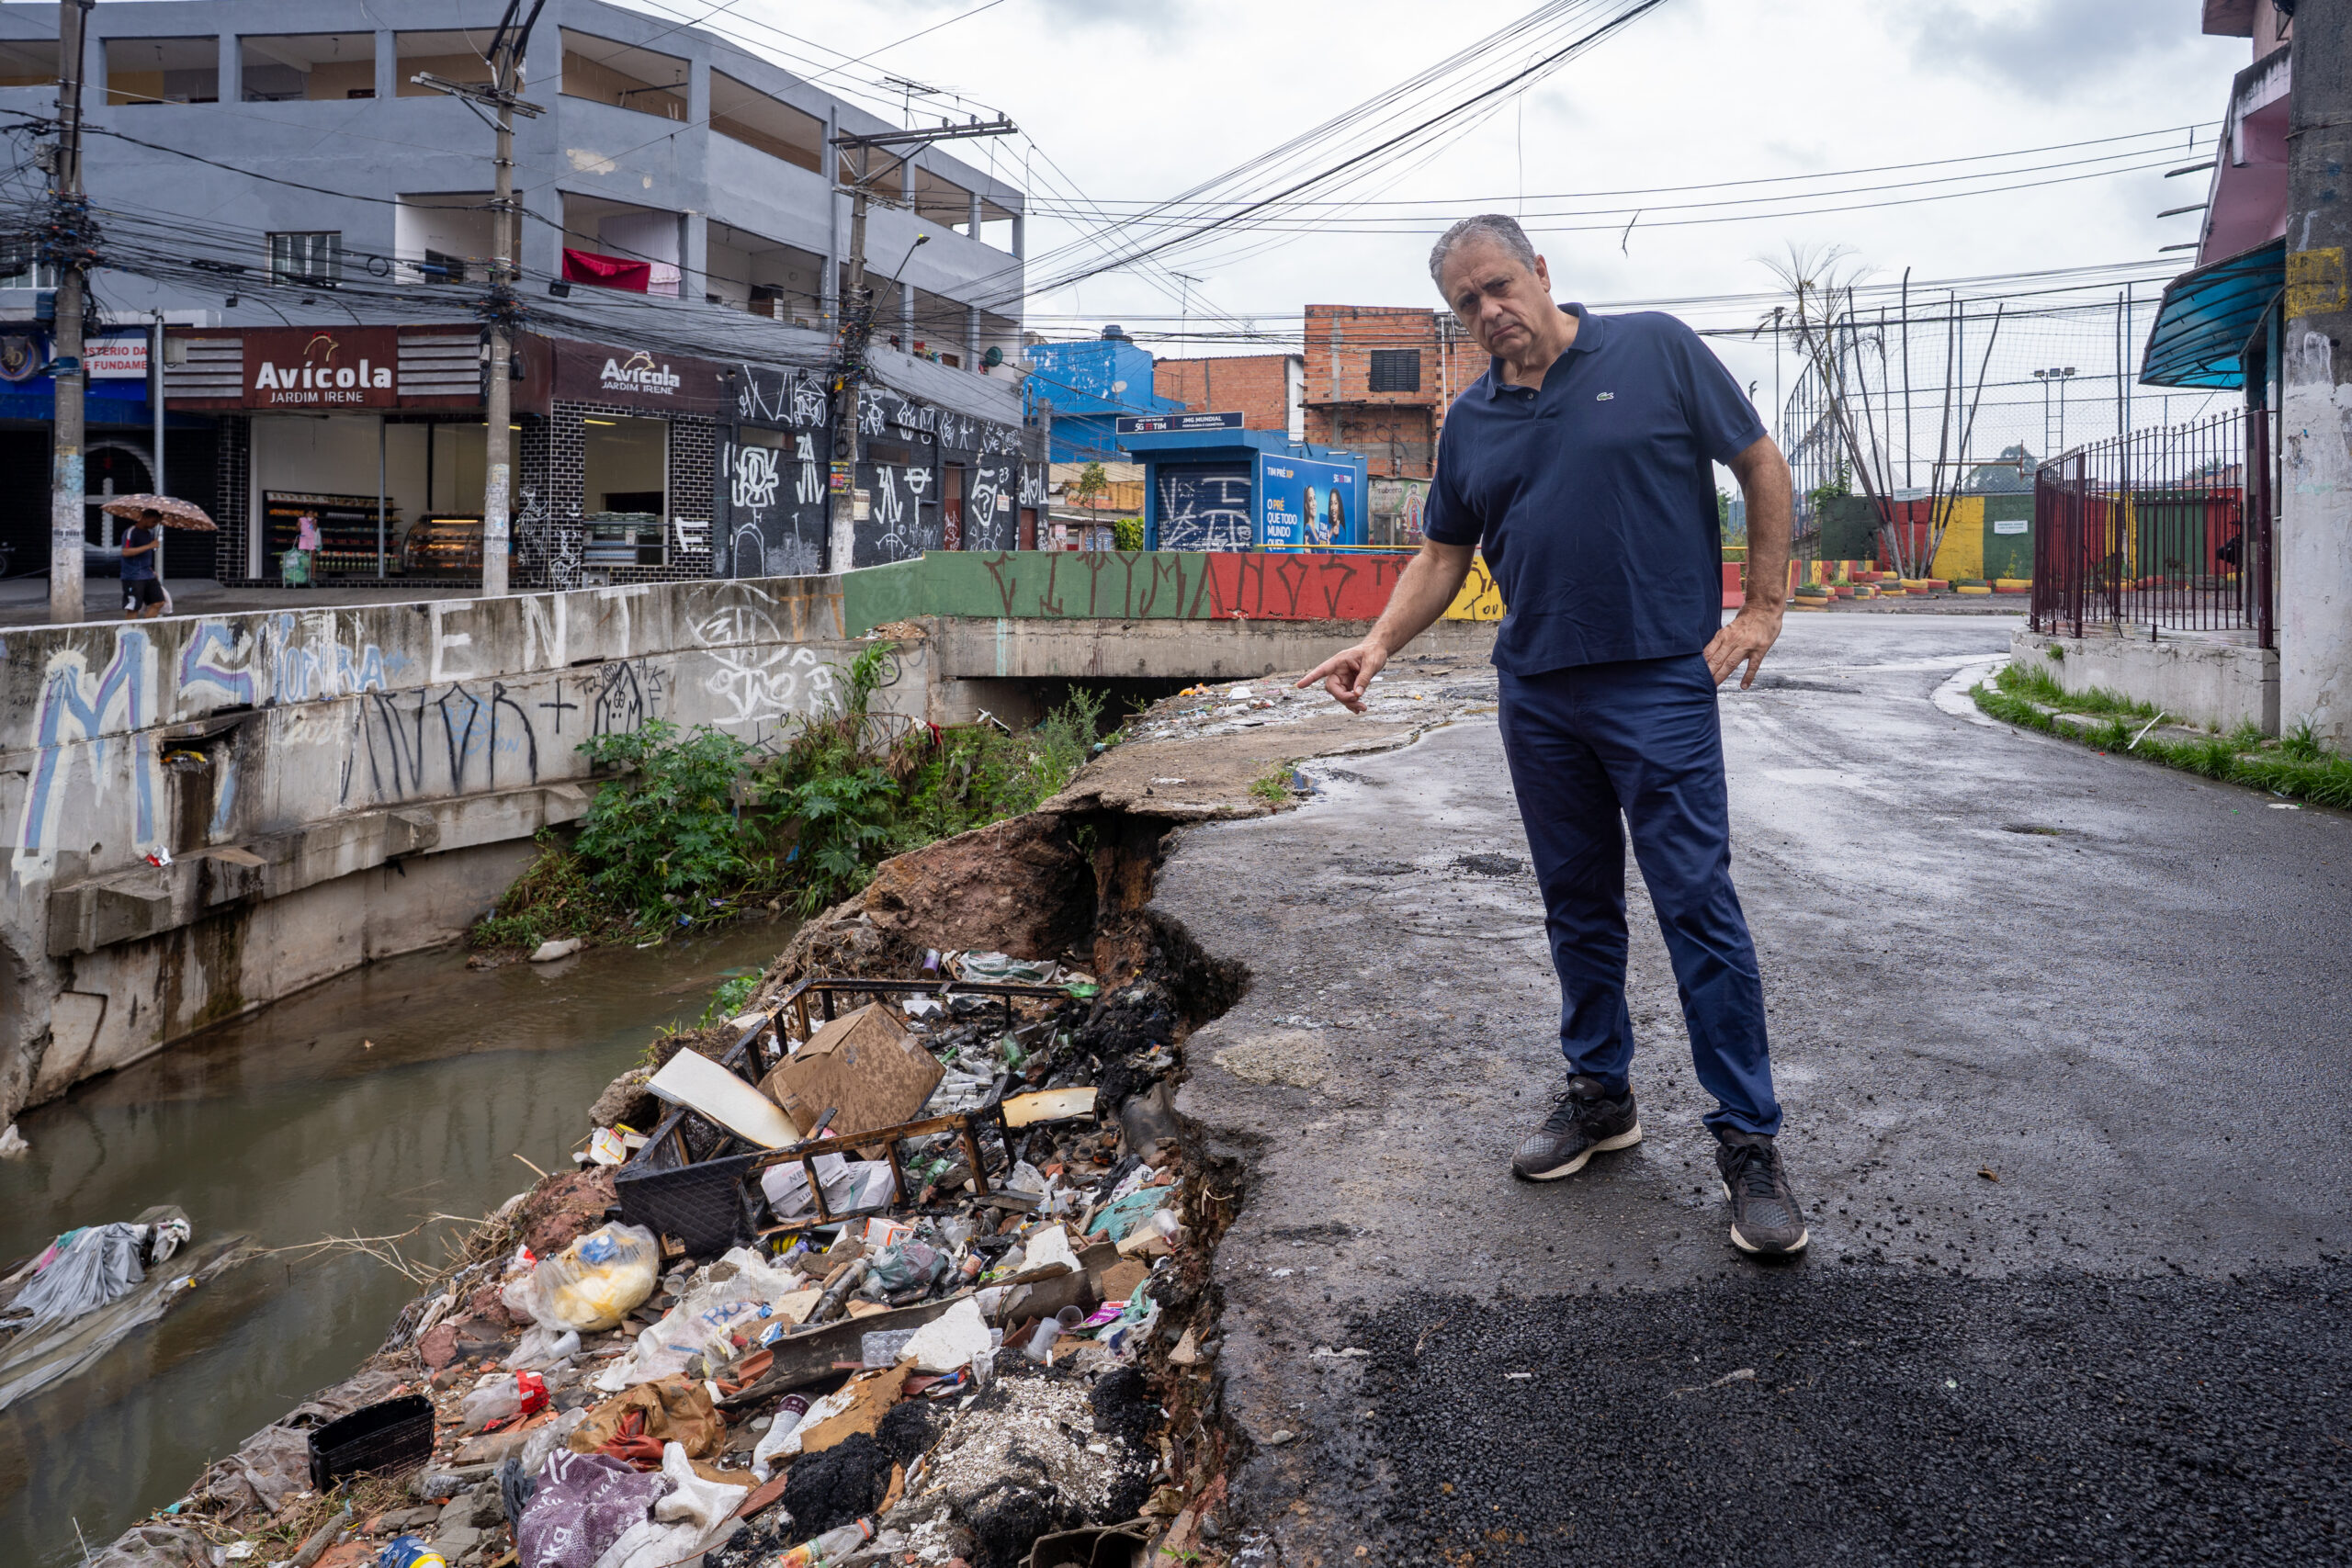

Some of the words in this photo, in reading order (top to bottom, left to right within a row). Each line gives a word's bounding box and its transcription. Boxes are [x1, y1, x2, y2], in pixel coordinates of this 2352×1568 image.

[84, 346, 129, 356] ISTERIO
[254, 358, 391, 389] Avícola
[600, 358, 680, 388] Avícola
[602, 381, 639, 392] JARDIM
[643, 384, 673, 395] IRENE
[269, 391, 319, 403] JARDIM
[324, 390, 364, 402] IRENE
[1153, 422, 1167, 430] TIM
[1267, 498, 1273, 510] O
[1272, 497, 1284, 512] PRÉ
[1267, 512, 1281, 525] QUE
[1281, 513, 1297, 525] TODO
[1267, 525, 1291, 537] MUNDO
